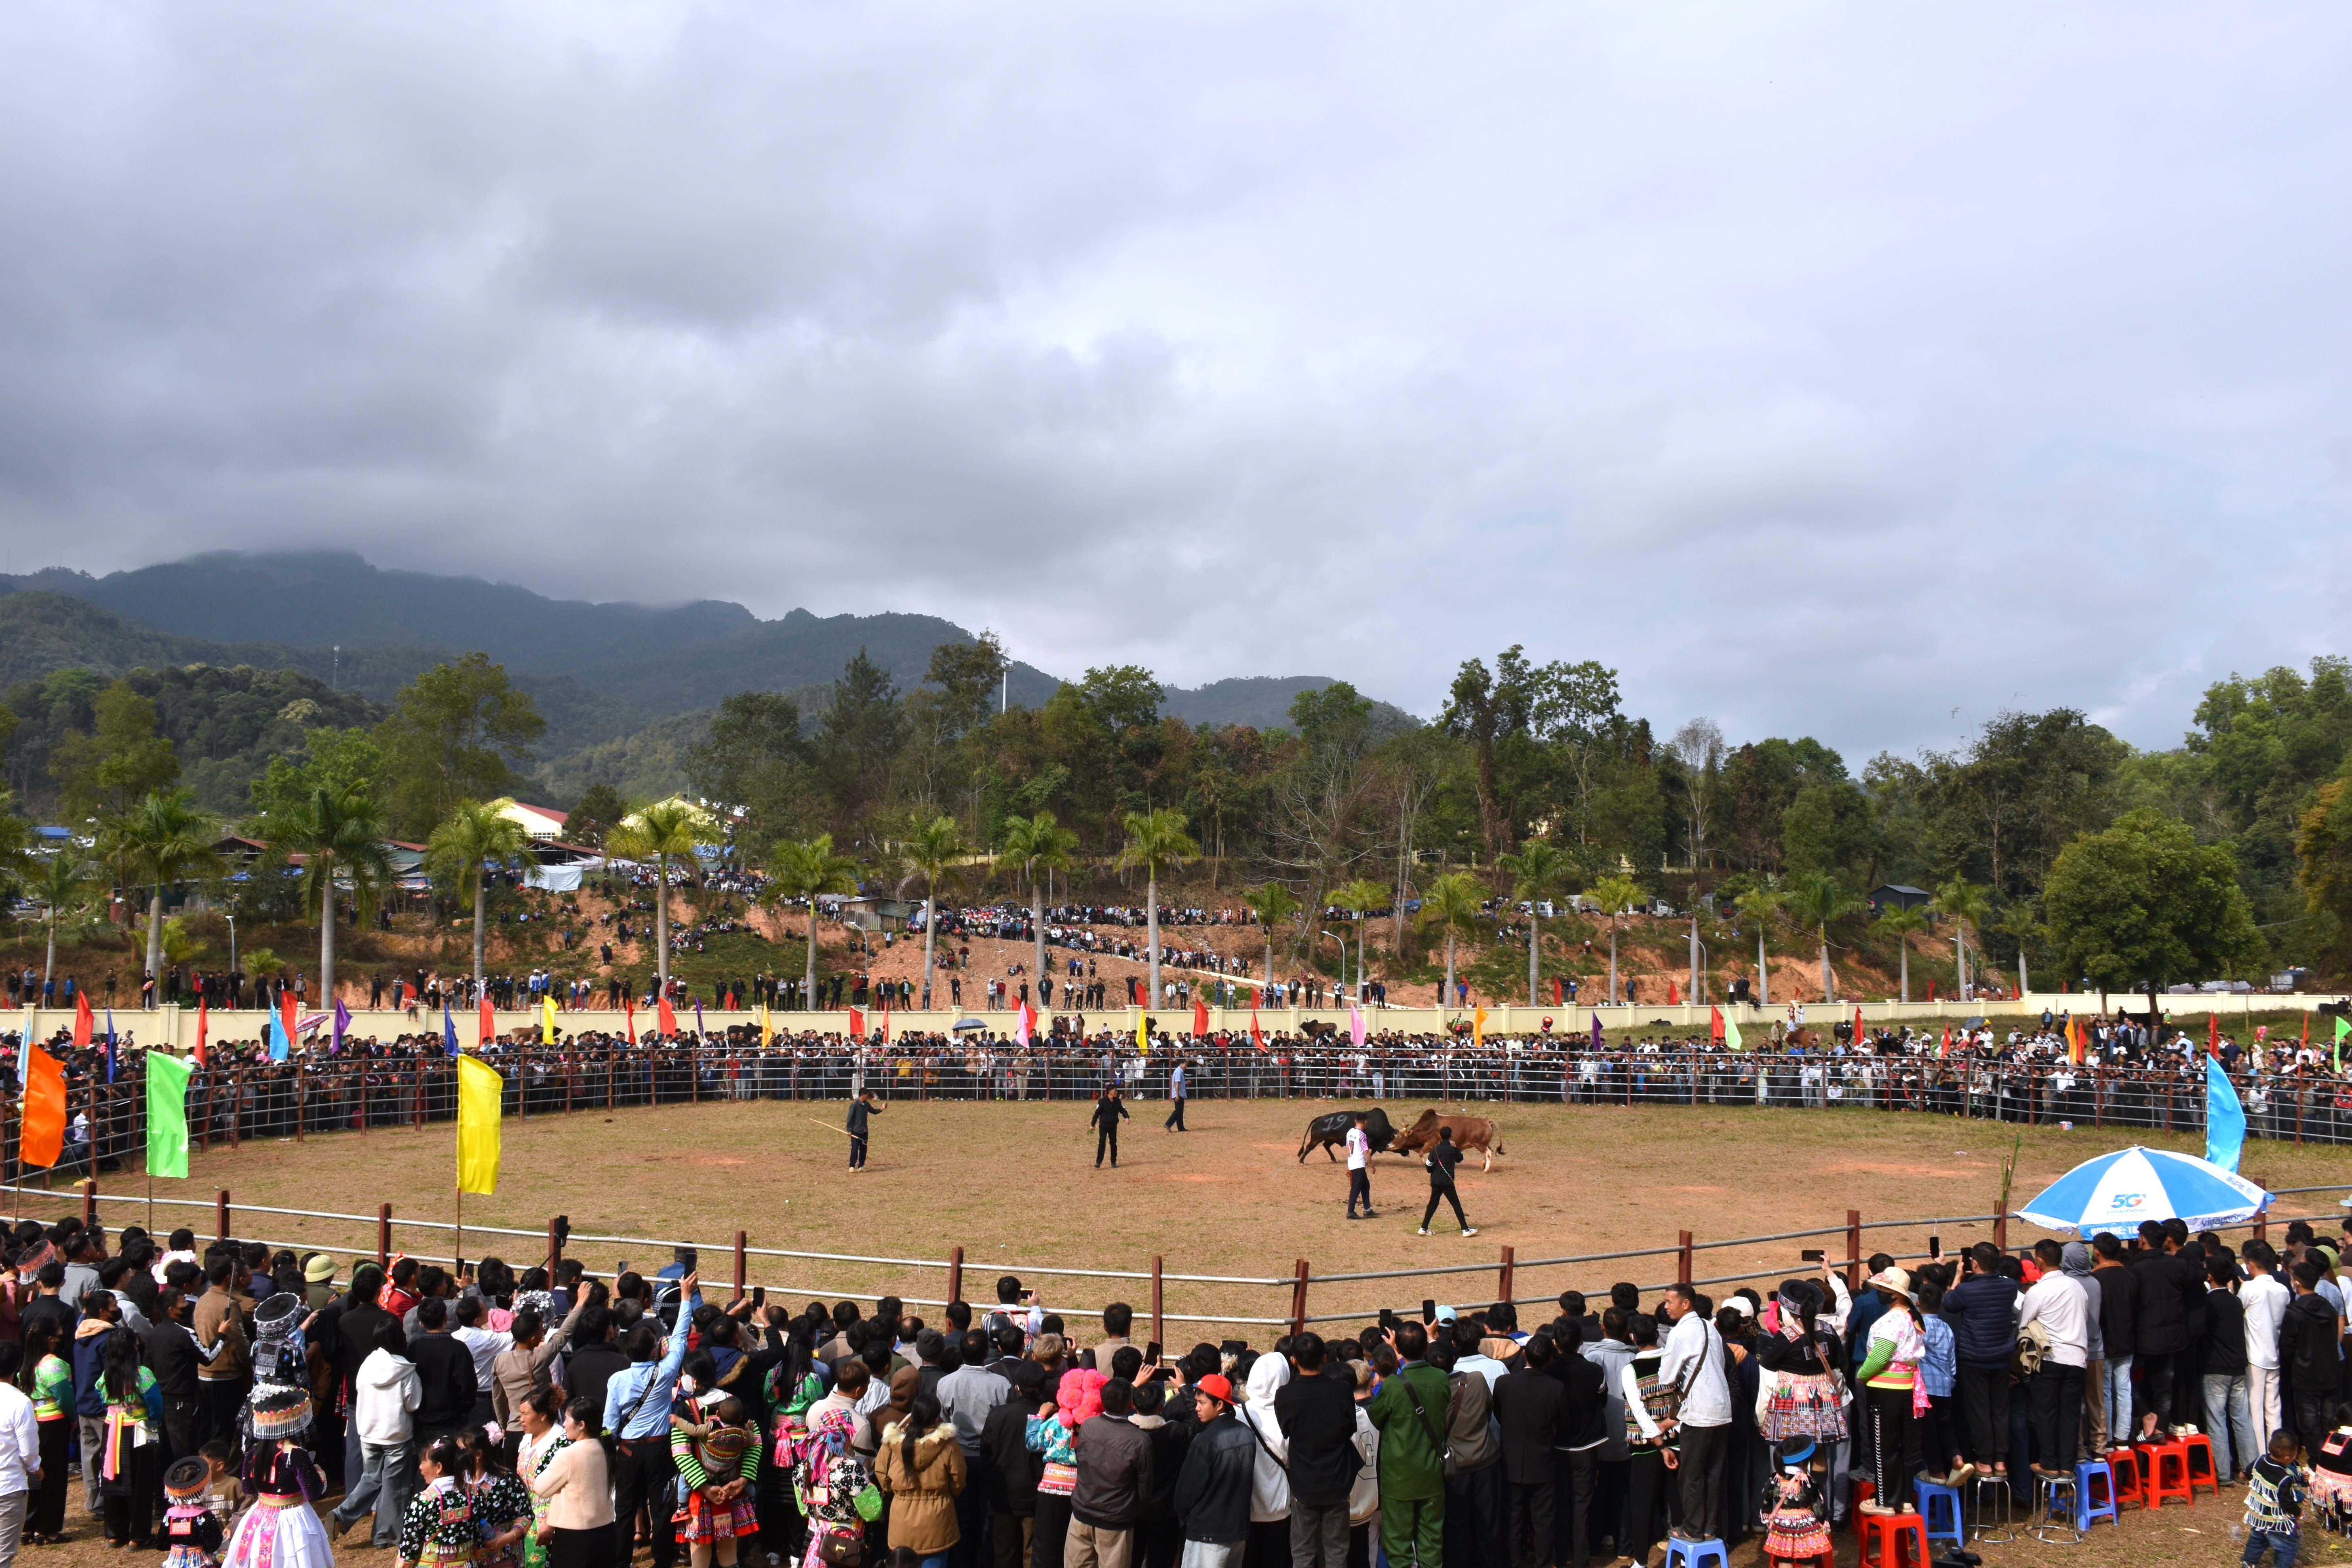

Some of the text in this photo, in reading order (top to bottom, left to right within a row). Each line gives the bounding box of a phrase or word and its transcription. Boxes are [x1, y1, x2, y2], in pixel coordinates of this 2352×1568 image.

[1322, 1115, 1347, 1131] 19
[2127, 1225, 2139, 1234] 18
[641, 1386, 652, 1402] adidas
[628, 1406, 639, 1419] adidas
